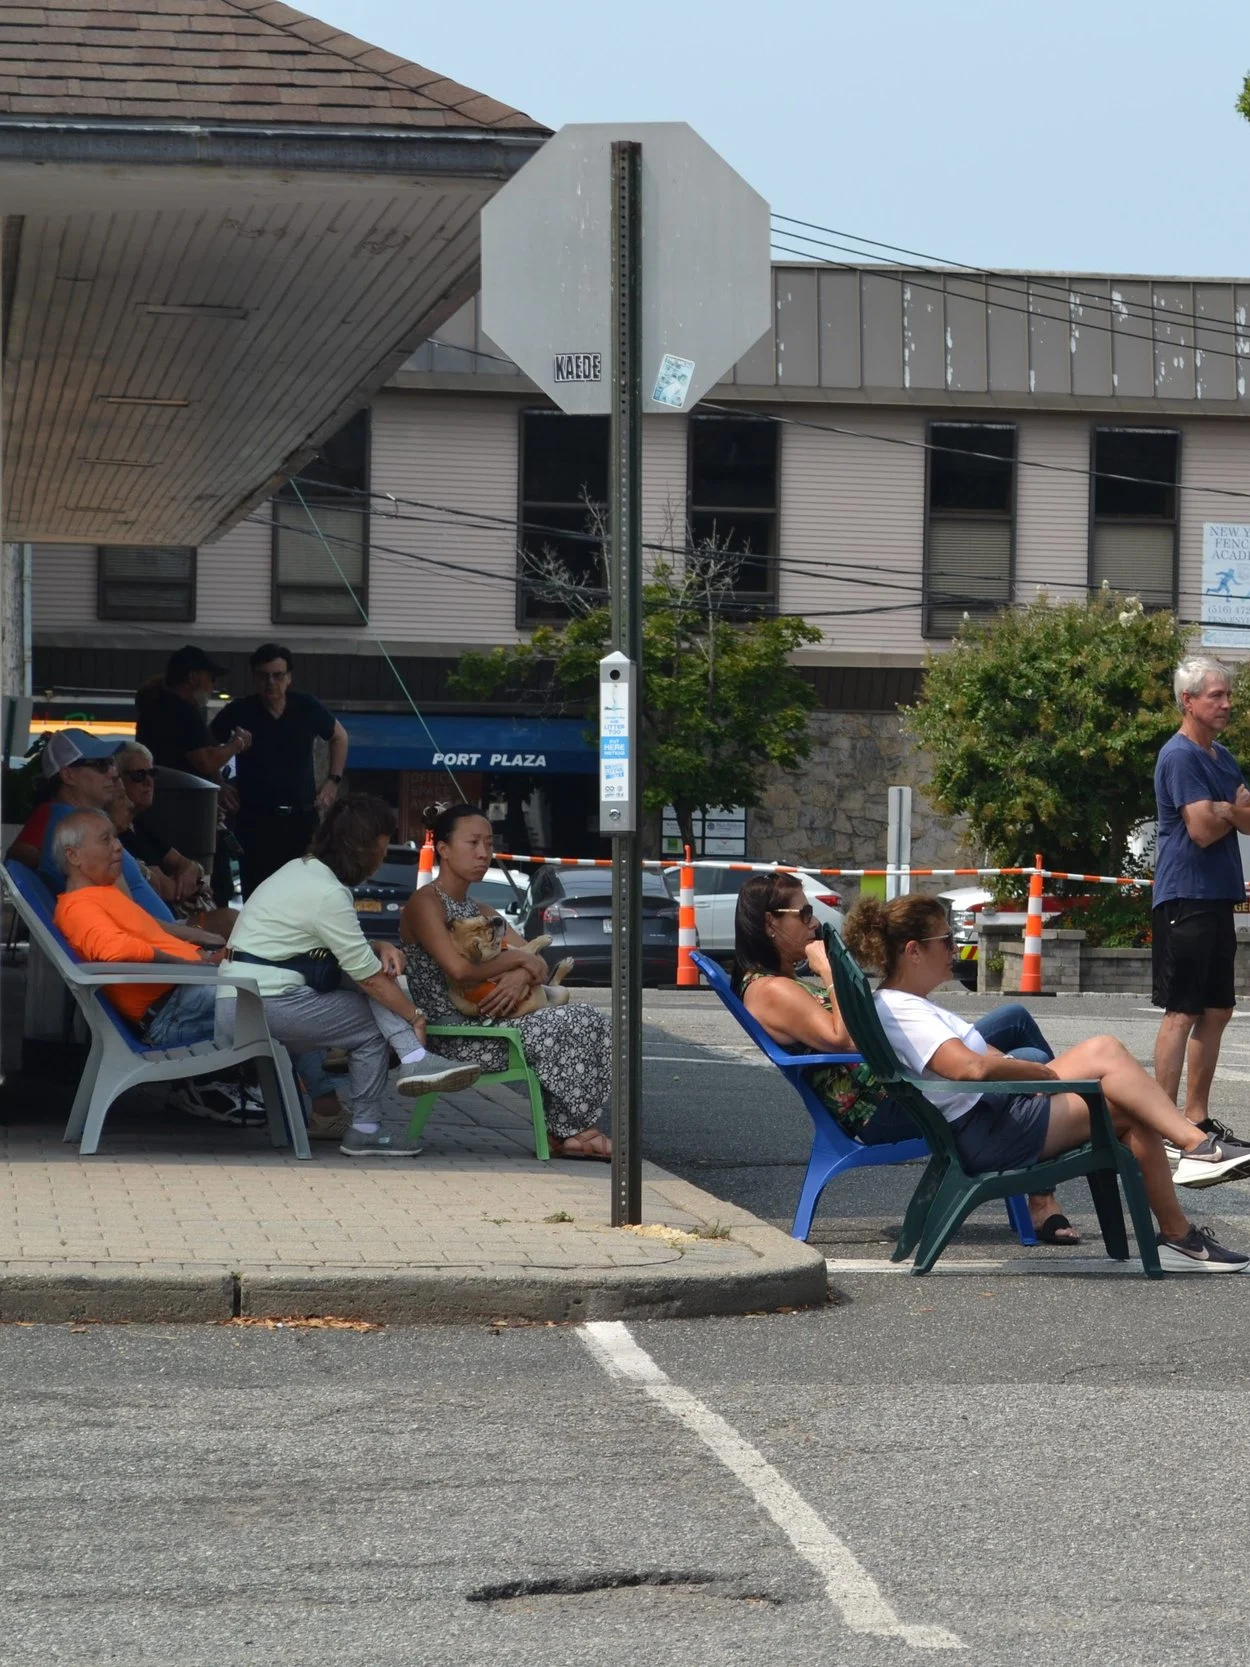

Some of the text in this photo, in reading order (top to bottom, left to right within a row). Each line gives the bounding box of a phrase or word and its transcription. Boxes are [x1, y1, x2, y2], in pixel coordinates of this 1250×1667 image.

[555, 354, 601, 381] KAEDE
[1210, 526, 1239, 537] NEW
[1208, 605, 1232, 614] (516)
[432, 753, 546, 767] PORT PLAZA
